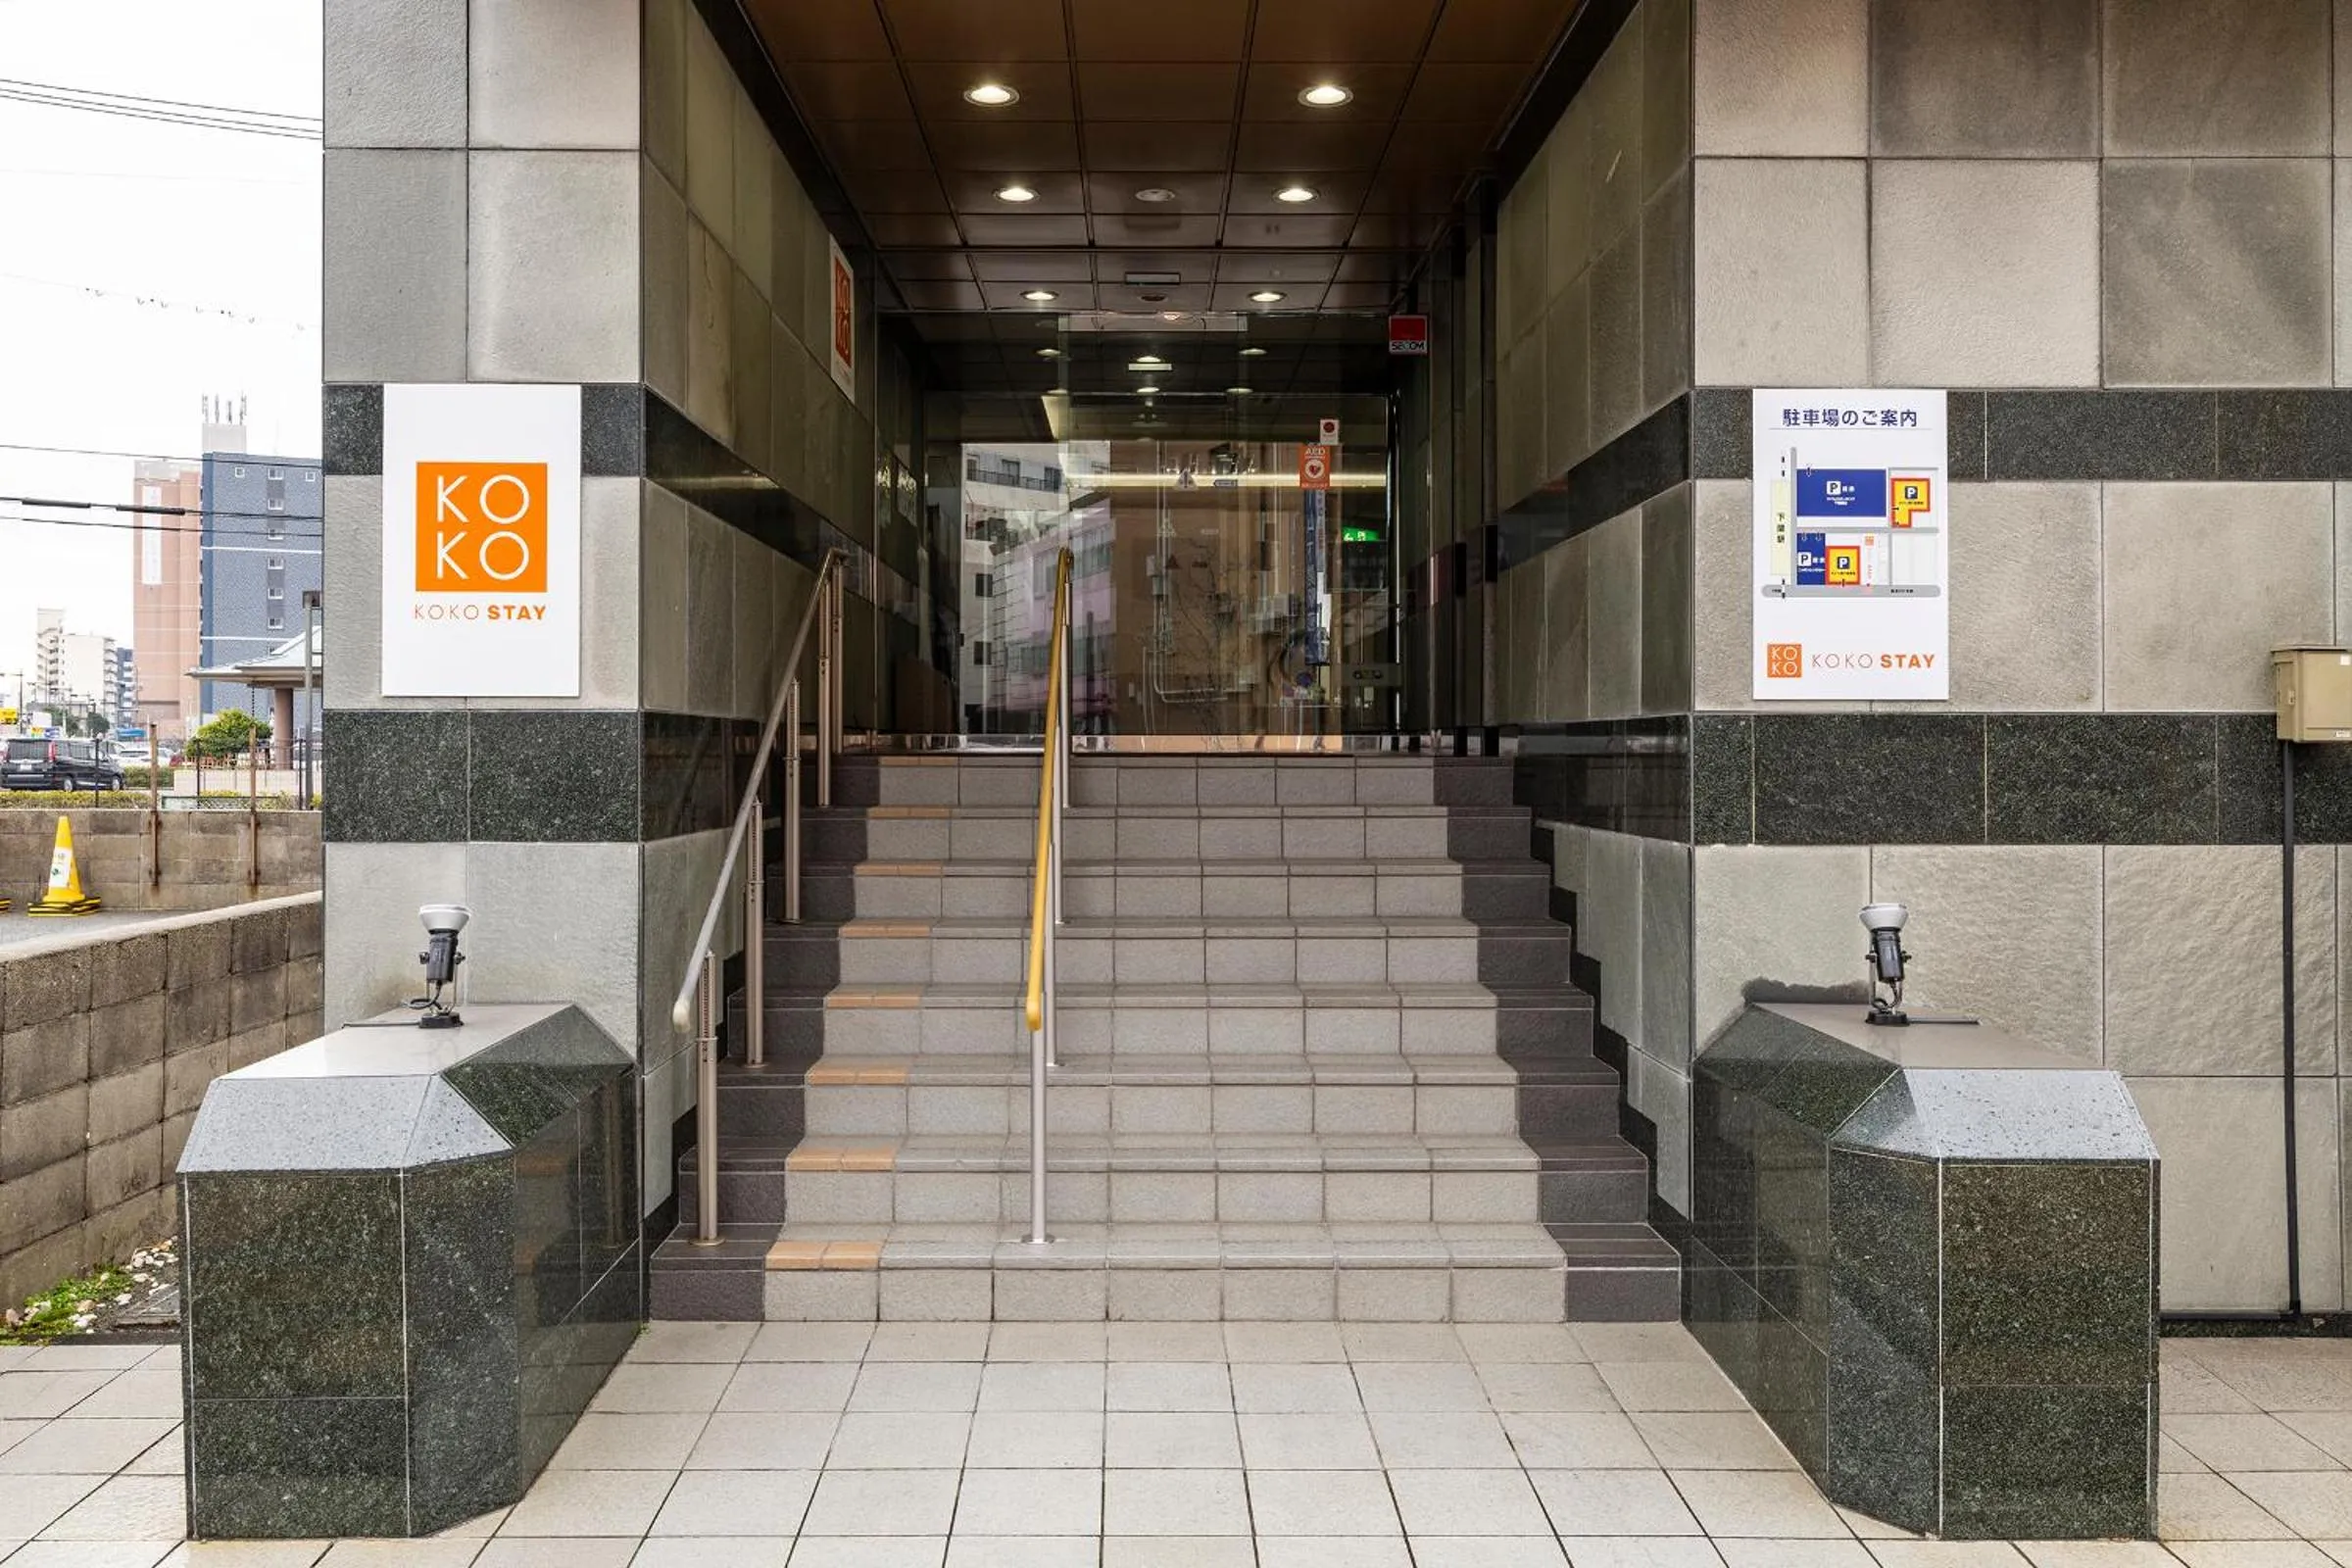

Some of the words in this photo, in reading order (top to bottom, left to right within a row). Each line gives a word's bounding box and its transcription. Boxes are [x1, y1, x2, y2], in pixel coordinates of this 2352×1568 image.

[1392, 341, 1425, 351] SECOM
[1783, 409, 1917, 427] 駐車場のご案内
[436, 474, 530, 524] KO
[436, 530, 530, 580] KO
[415, 604, 479, 620] KOKO
[487, 605, 546, 620] STAY
[1771, 646, 1798, 661] KO
[1812, 653, 1874, 668] KOKO
[1880, 654, 1936, 668] STAY
[1771, 661, 1798, 675] KO
